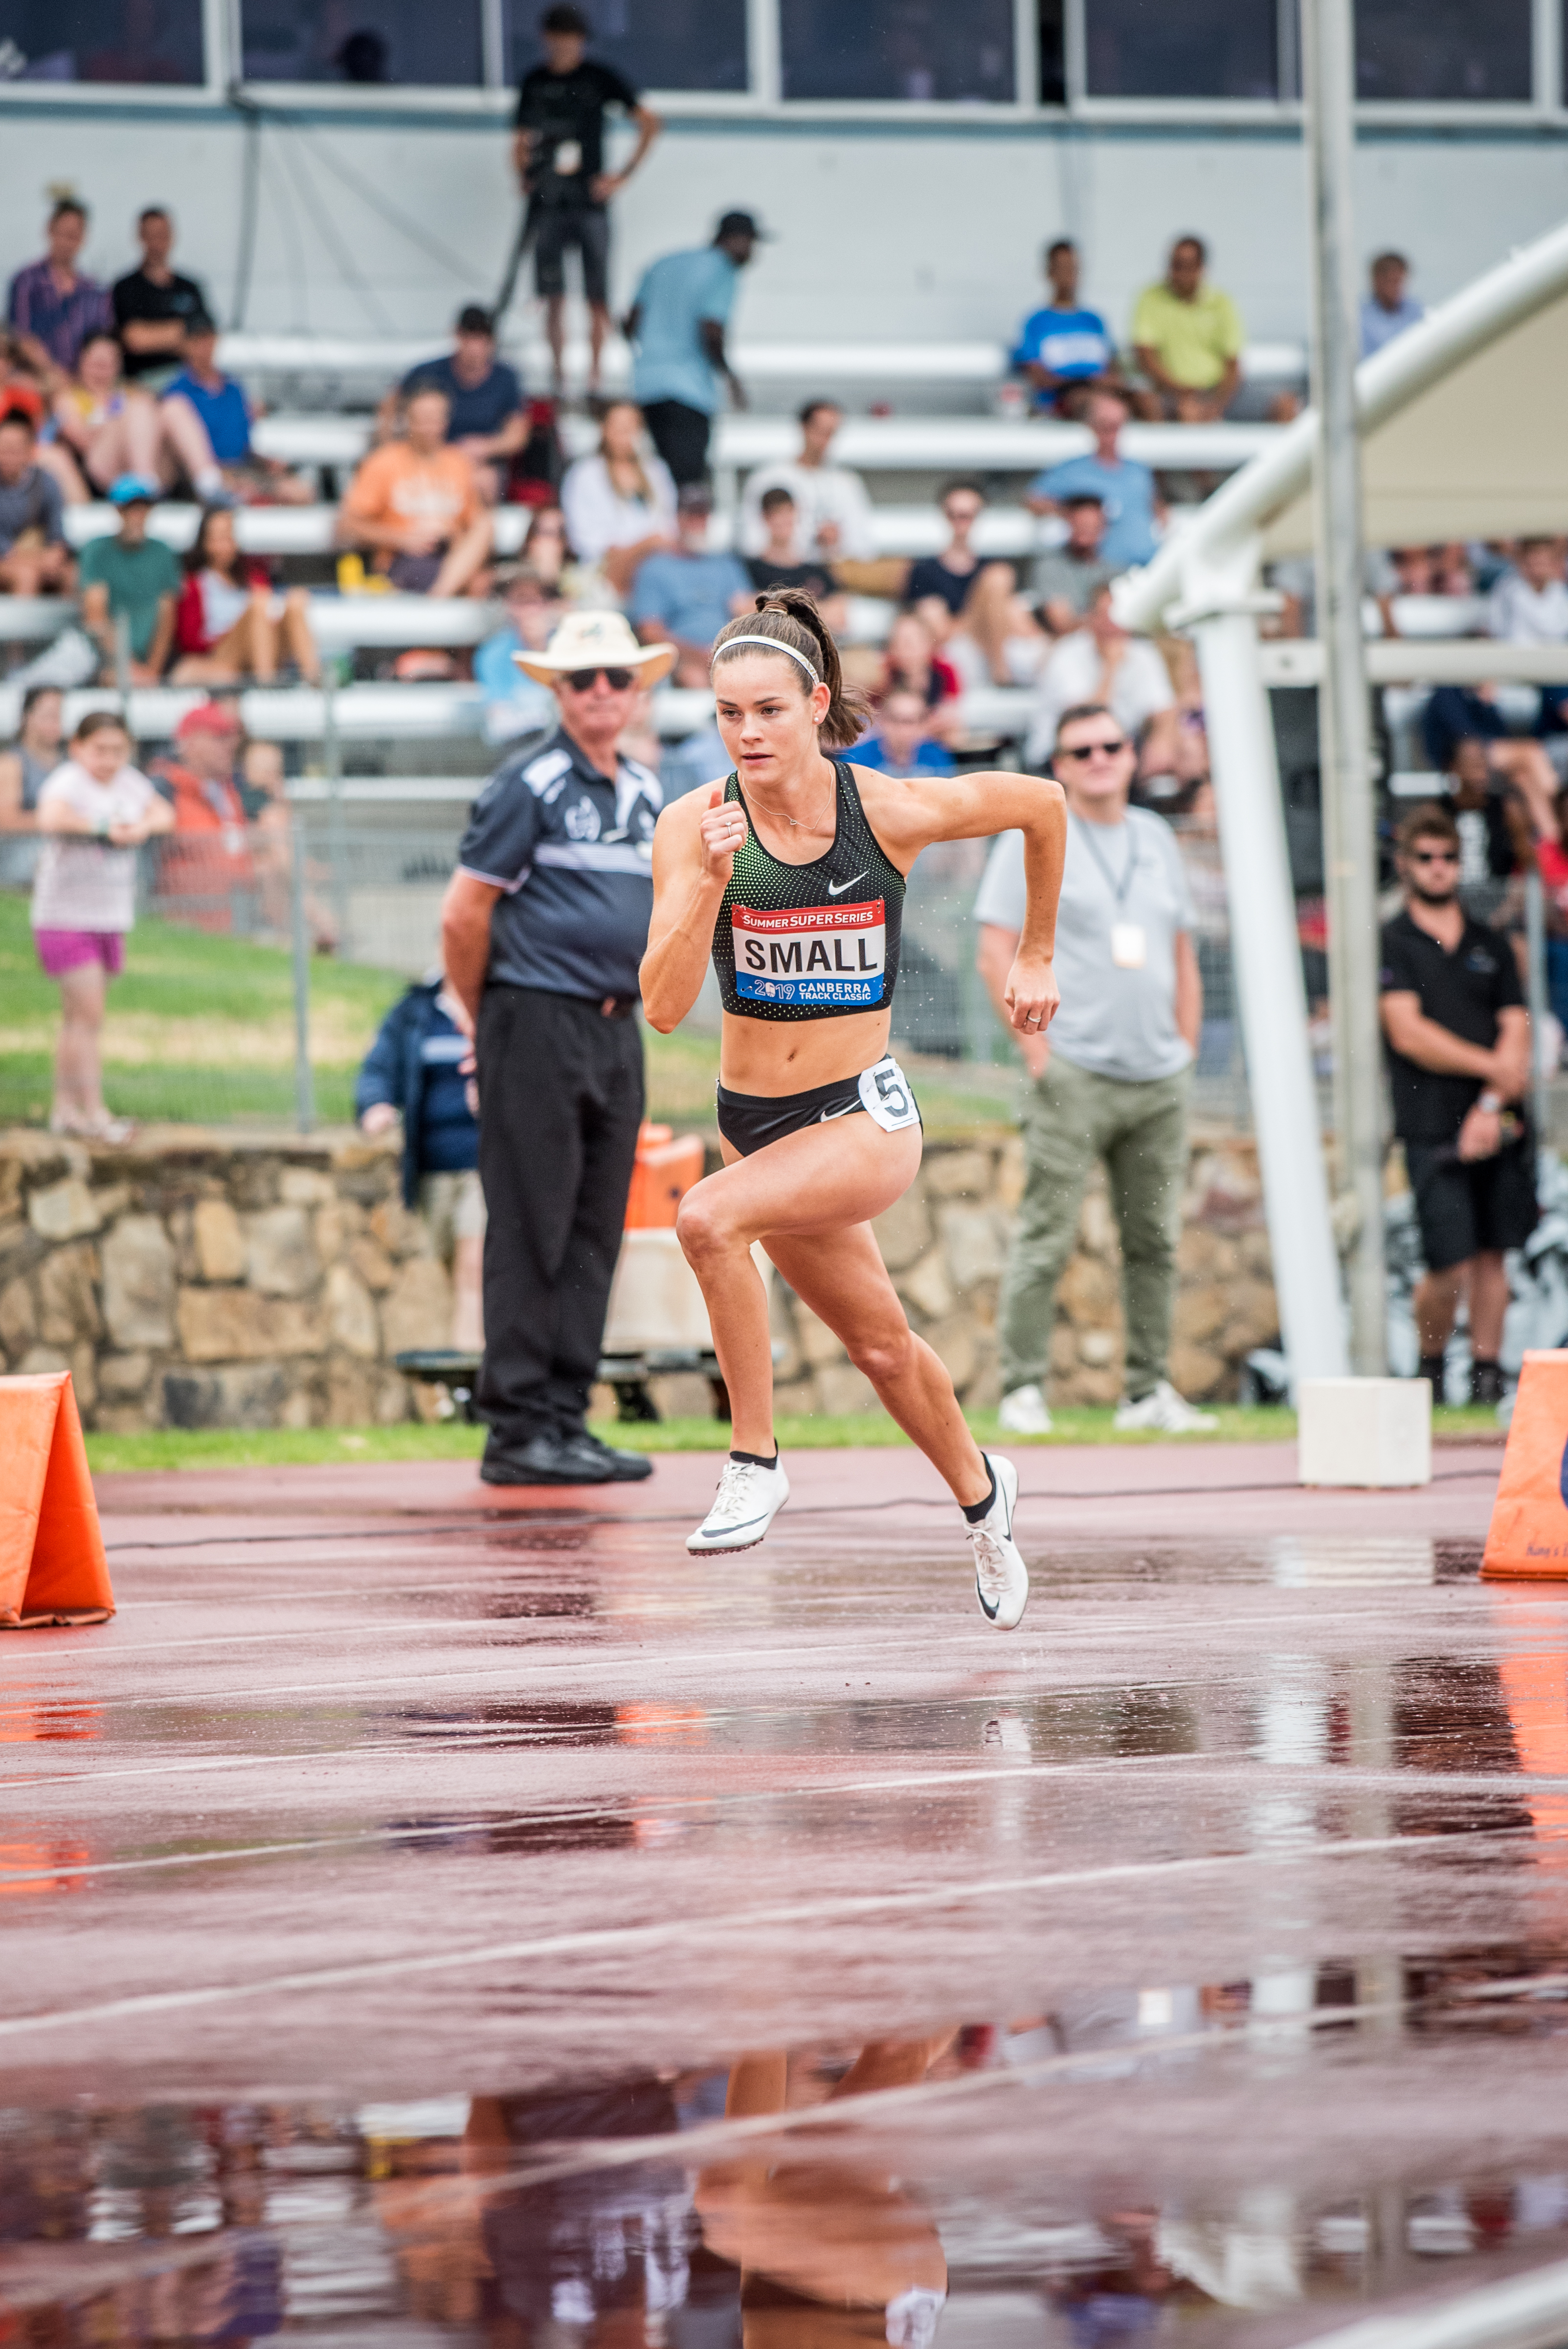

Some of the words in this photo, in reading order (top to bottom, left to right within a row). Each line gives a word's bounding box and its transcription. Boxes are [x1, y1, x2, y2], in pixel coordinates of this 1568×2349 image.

[743, 915, 789, 928] SUMMER
[790, 914, 833, 926] SUPER
[834, 911, 873, 924] SERIES
[744, 938, 878, 973] SMALL
[754, 980, 795, 1000] 2019
[799, 983, 871, 993] CANBERRA
[832, 992, 871, 1001] CLASSIC
[874, 1068, 909, 1118] 5
